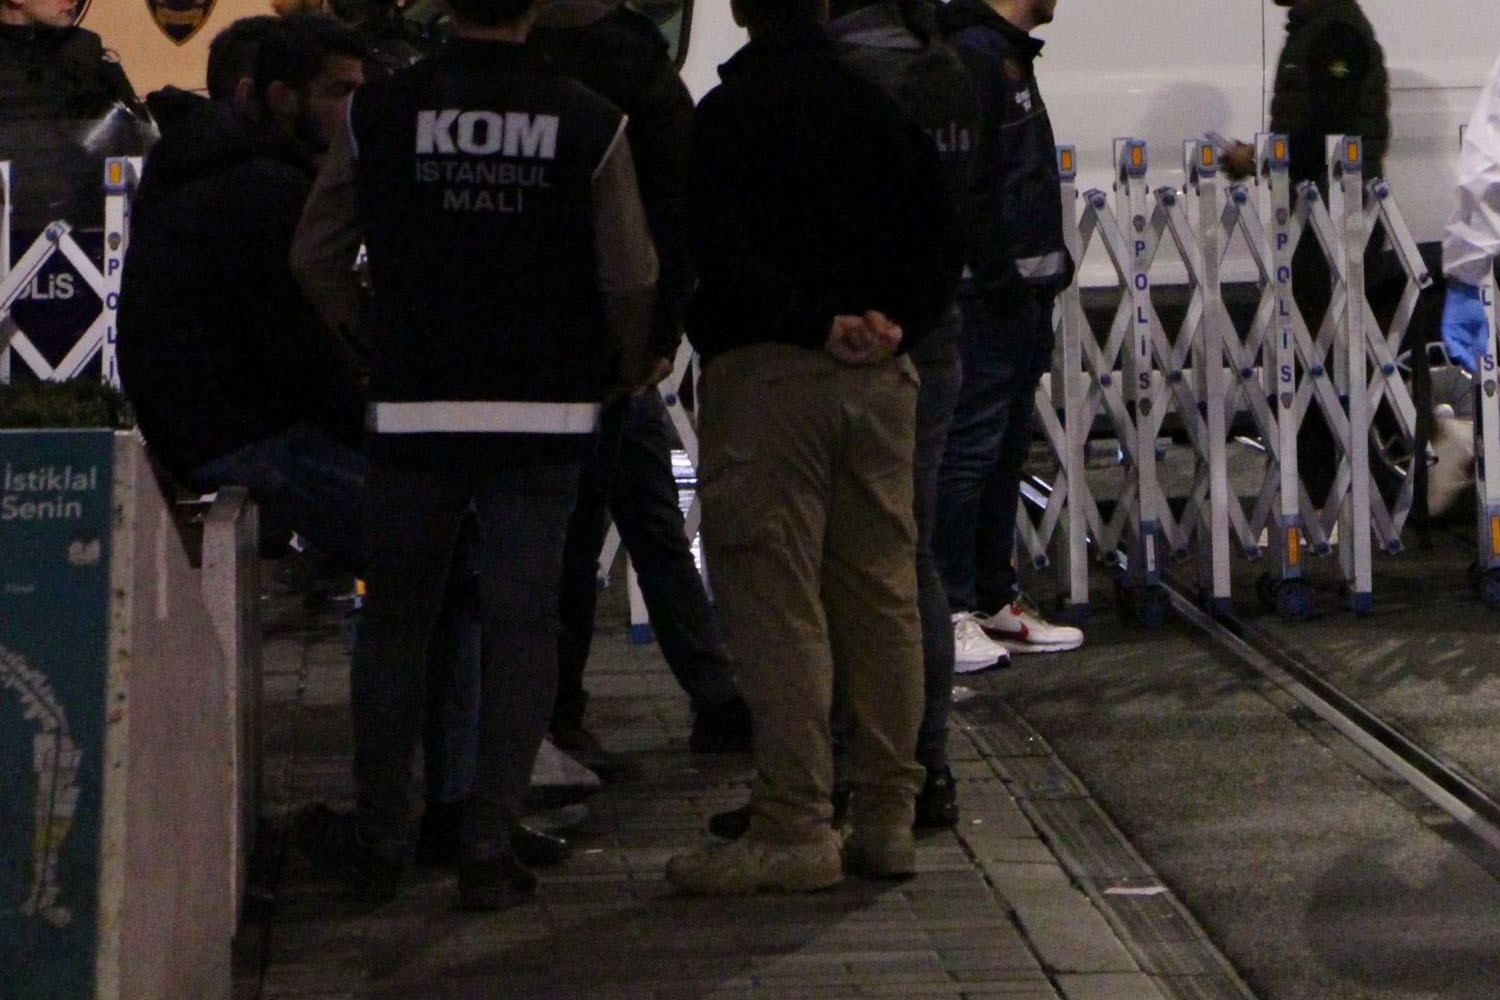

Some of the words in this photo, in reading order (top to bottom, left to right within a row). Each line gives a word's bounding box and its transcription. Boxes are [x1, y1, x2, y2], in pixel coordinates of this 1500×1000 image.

[415, 109, 560, 160] KOM
[415, 157, 552, 188] İSTANBUL
[106, 259, 120, 379] POLİ
[1134, 240, 1150, 390] POLİS
[1276, 233, 1292, 383] POLİS
[4, 462, 98, 492] İstiklal
[1, 495, 83, 521] Senin
